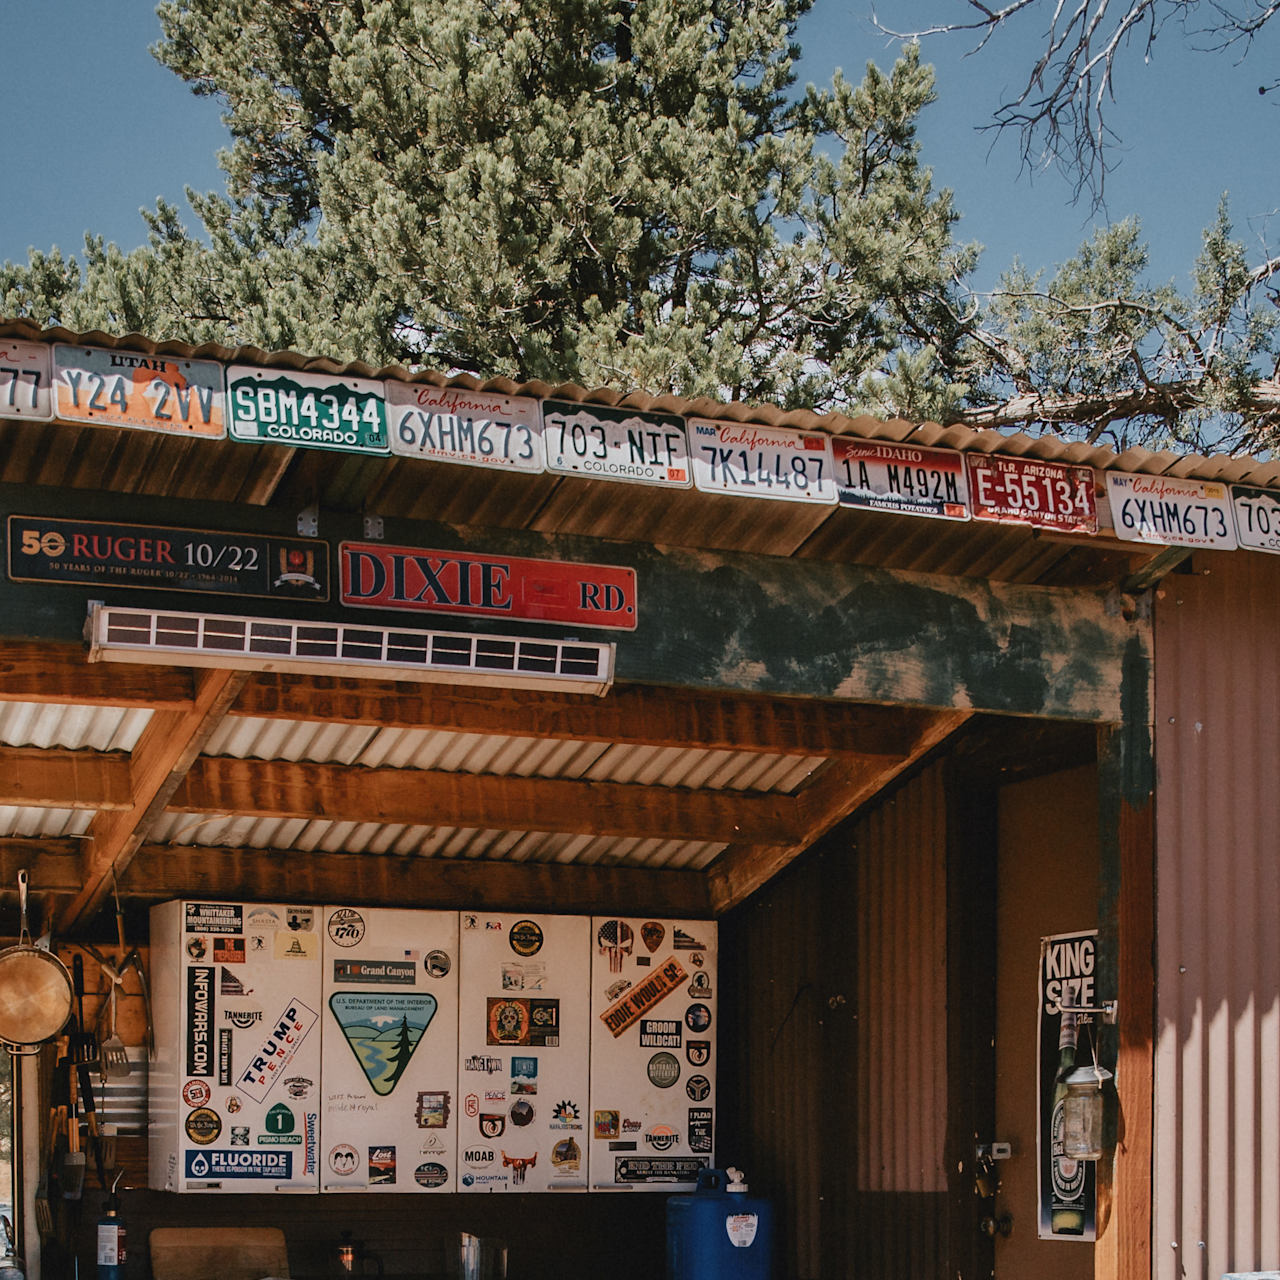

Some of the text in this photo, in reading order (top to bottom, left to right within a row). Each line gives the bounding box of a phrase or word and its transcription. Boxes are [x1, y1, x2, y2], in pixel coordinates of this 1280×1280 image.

[110, 355, 166, 372] UTAH
[67, 370, 127, 413] Y24
[236, 386, 380, 432] SBM4344
[418, 389, 512, 415] California
[267, 425, 356, 444] COLORADO
[400, 411, 533, 459] 6XHM673
[696, 426, 716, 436] MAR
[720, 426, 807, 450] California
[428, 448, 506, 464] dmv.ca.gov
[876, 447, 922, 462] IDAHO
[584, 461, 654, 477] COLORADO
[701, 446, 823, 492] 7K14487
[998, 462, 1063, 479] TLR. ARIZONA
[843, 459, 958, 502] 1A M492M
[1113, 477, 1127, 487] MAY
[1133, 478, 1207, 499] California
[977, 469, 1090, 516] E-55134
[870, 500, 938, 514] FAMOUS POTATOES
[1021, 509, 1056, 520] CANYON
[1122, 499, 1227, 536] 6XHM673
[21, 530, 259, 571] 50 RUGER 10/22
[63, 563, 91, 572] YEARS
[110, 566, 127, 575] THE
[343, 551, 633, 613] DIXIE RD.
[187, 916, 242, 925] MOUNTAINEERING
[200, 908, 235, 917] WHITTAKER
[1046, 940, 1095, 980] KING
[361, 965, 385, 976] Grand
[387, 966, 414, 978] Canyon
[1046, 976, 1094, 1015] SIZE
[192, 968, 210, 1075] INFOWARS.COM
[224, 1010, 263, 1021] TANNERITE
[605, 1001, 635, 1032] EDDIE
[646, 1021, 676, 1033] GROOM
[243, 1007, 298, 1084] TRUMP
[641, 1034, 680, 1047] WILDCAT!
[258, 1021, 303, 1086] PENCE
[276, 1114, 282, 1130] 1
[307, 1113, 317, 1175] Sweetwater
[645, 1134, 679, 1143] TANNERITE
[211, 1153, 287, 1166] FLUORIDE
[465, 1151, 494, 1161] MOAB
